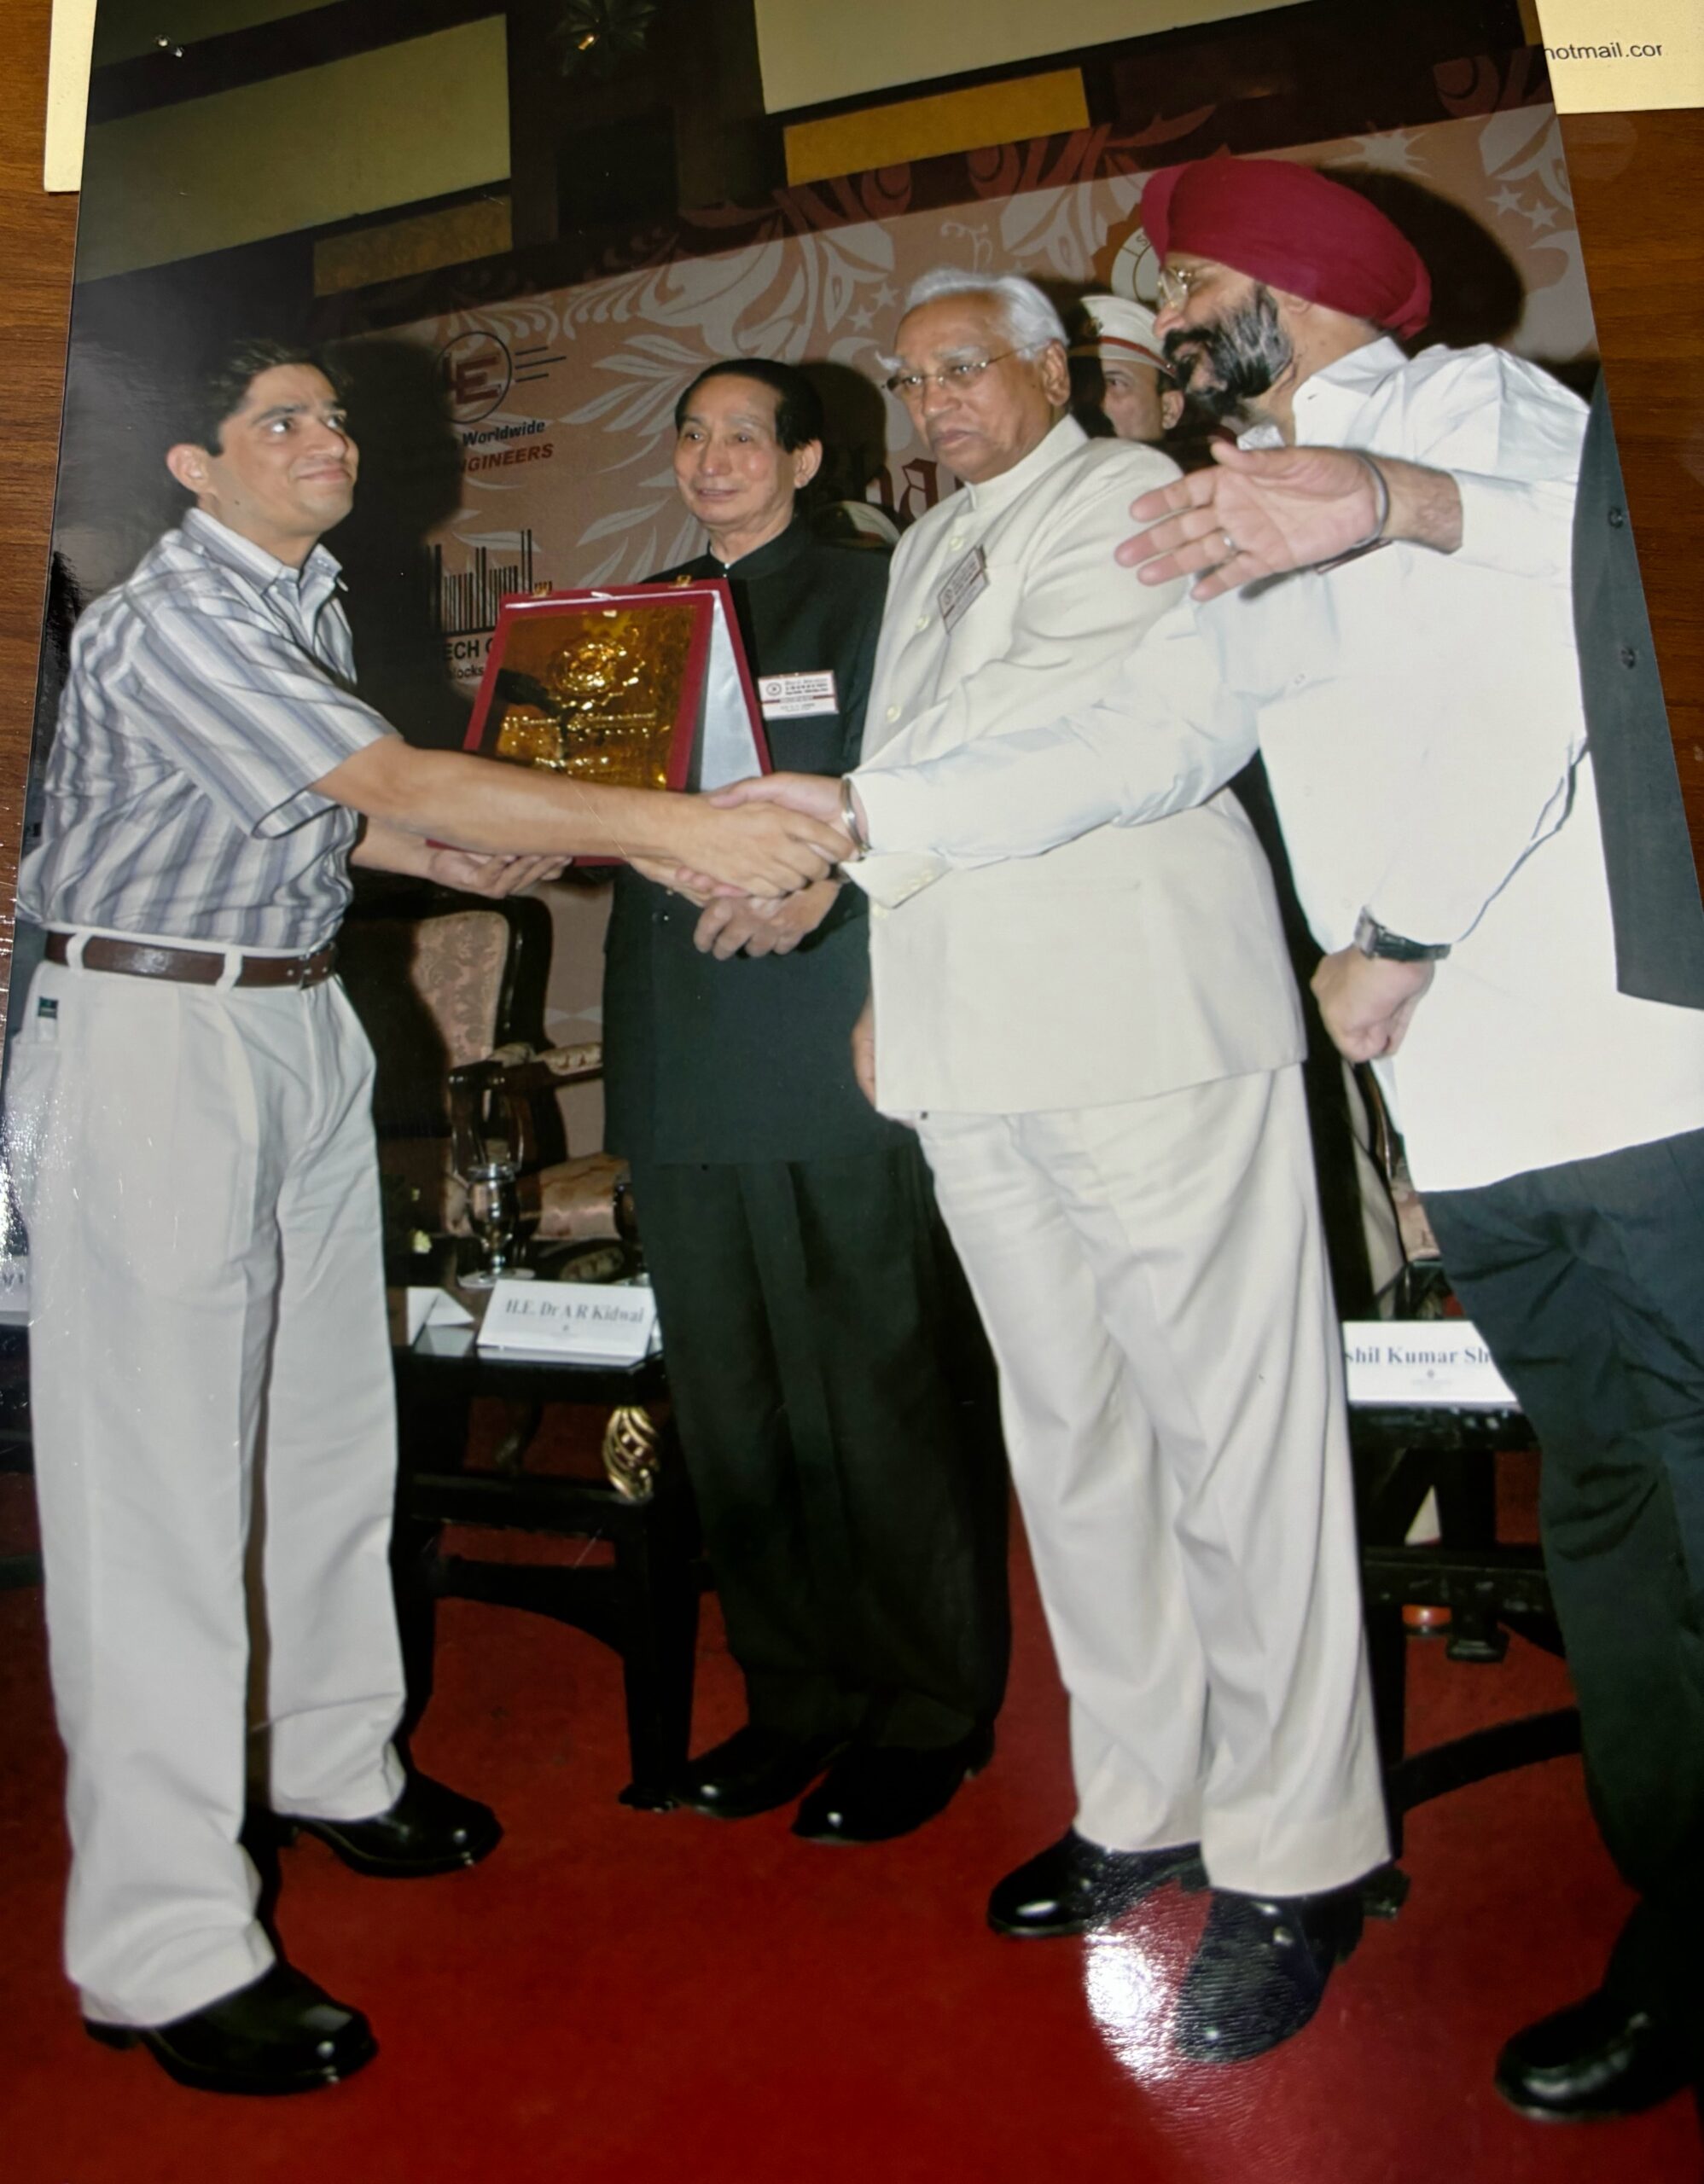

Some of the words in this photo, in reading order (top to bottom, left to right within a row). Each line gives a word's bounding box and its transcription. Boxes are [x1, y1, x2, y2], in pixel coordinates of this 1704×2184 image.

[462, 420, 546, 446] Worldwide
[540, 1301, 560, 1317] Dr
[576, 1304, 589, 1320] R
[1387, 1346, 1458, 1364] Kumar
